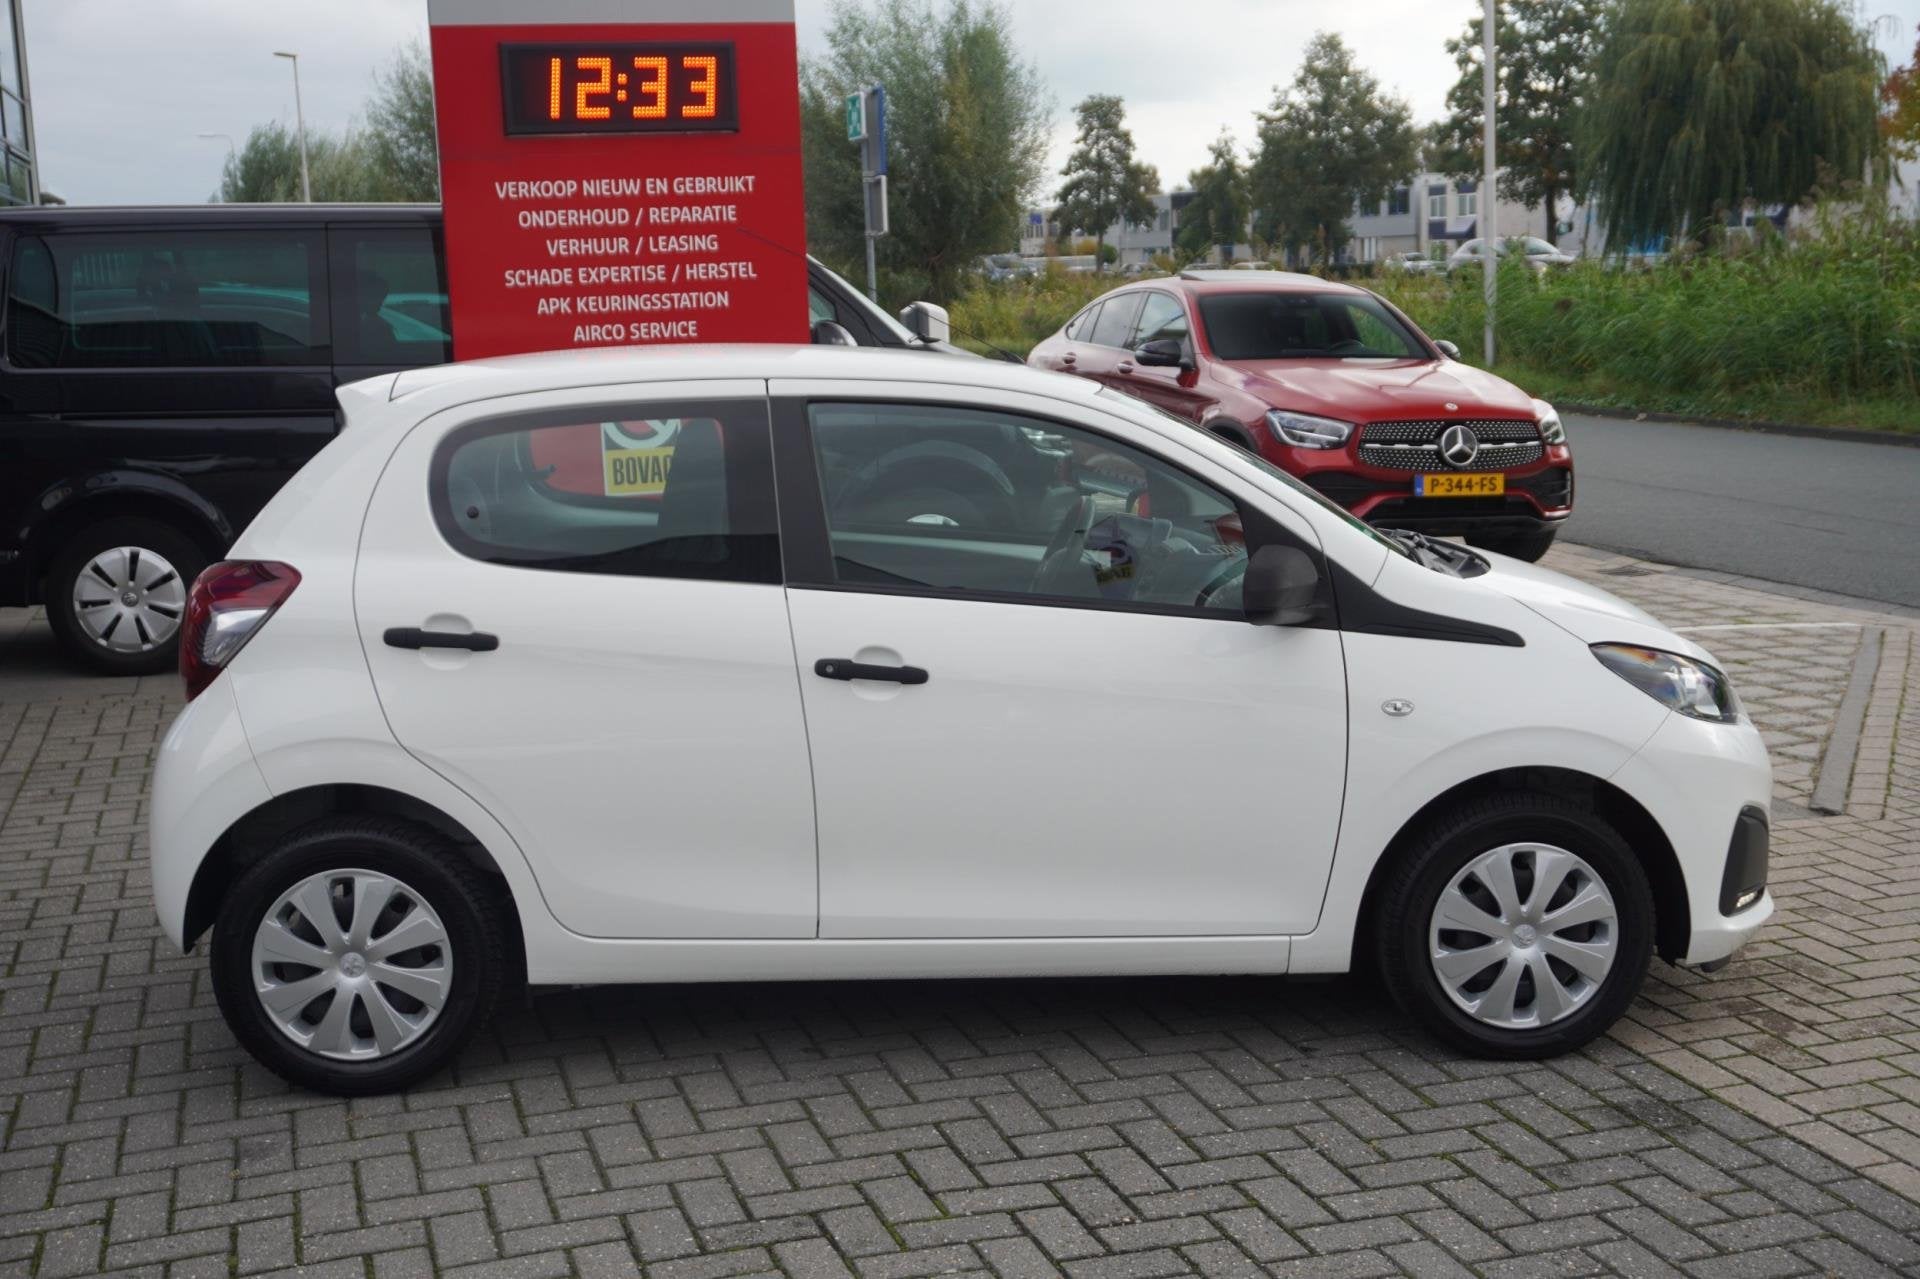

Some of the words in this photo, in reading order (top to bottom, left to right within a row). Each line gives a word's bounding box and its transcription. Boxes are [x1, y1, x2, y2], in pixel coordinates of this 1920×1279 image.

[550, 57, 716, 119] 12:33
[495, 180, 577, 199] VERKOOP
[582, 178, 641, 196] NIEUW
[645, 178, 669, 194] EN
[673, 175, 756, 194] GEBRUIKT
[518, 207, 630, 228] ONDERHOUD
[635, 208, 644, 226] /
[649, 205, 737, 223] REPARATIE
[546, 236, 630, 256] VERHUUR
[635, 237, 644, 255] /
[649, 234, 719, 251] LEASING
[504, 268, 574, 286] SCHADE
[578, 265, 667, 284] EXPERTISE
[671, 264, 681, 282] /
[685, 262, 758, 280] HERSTEL
[537, 297, 572, 315] APK
[576, 291, 730, 313] KEURINGSSTATION
[574, 323, 626, 341] AIRCO
[629, 321, 699, 338] SERVICE
[1431, 477, 1497, 492] P-344-FS
